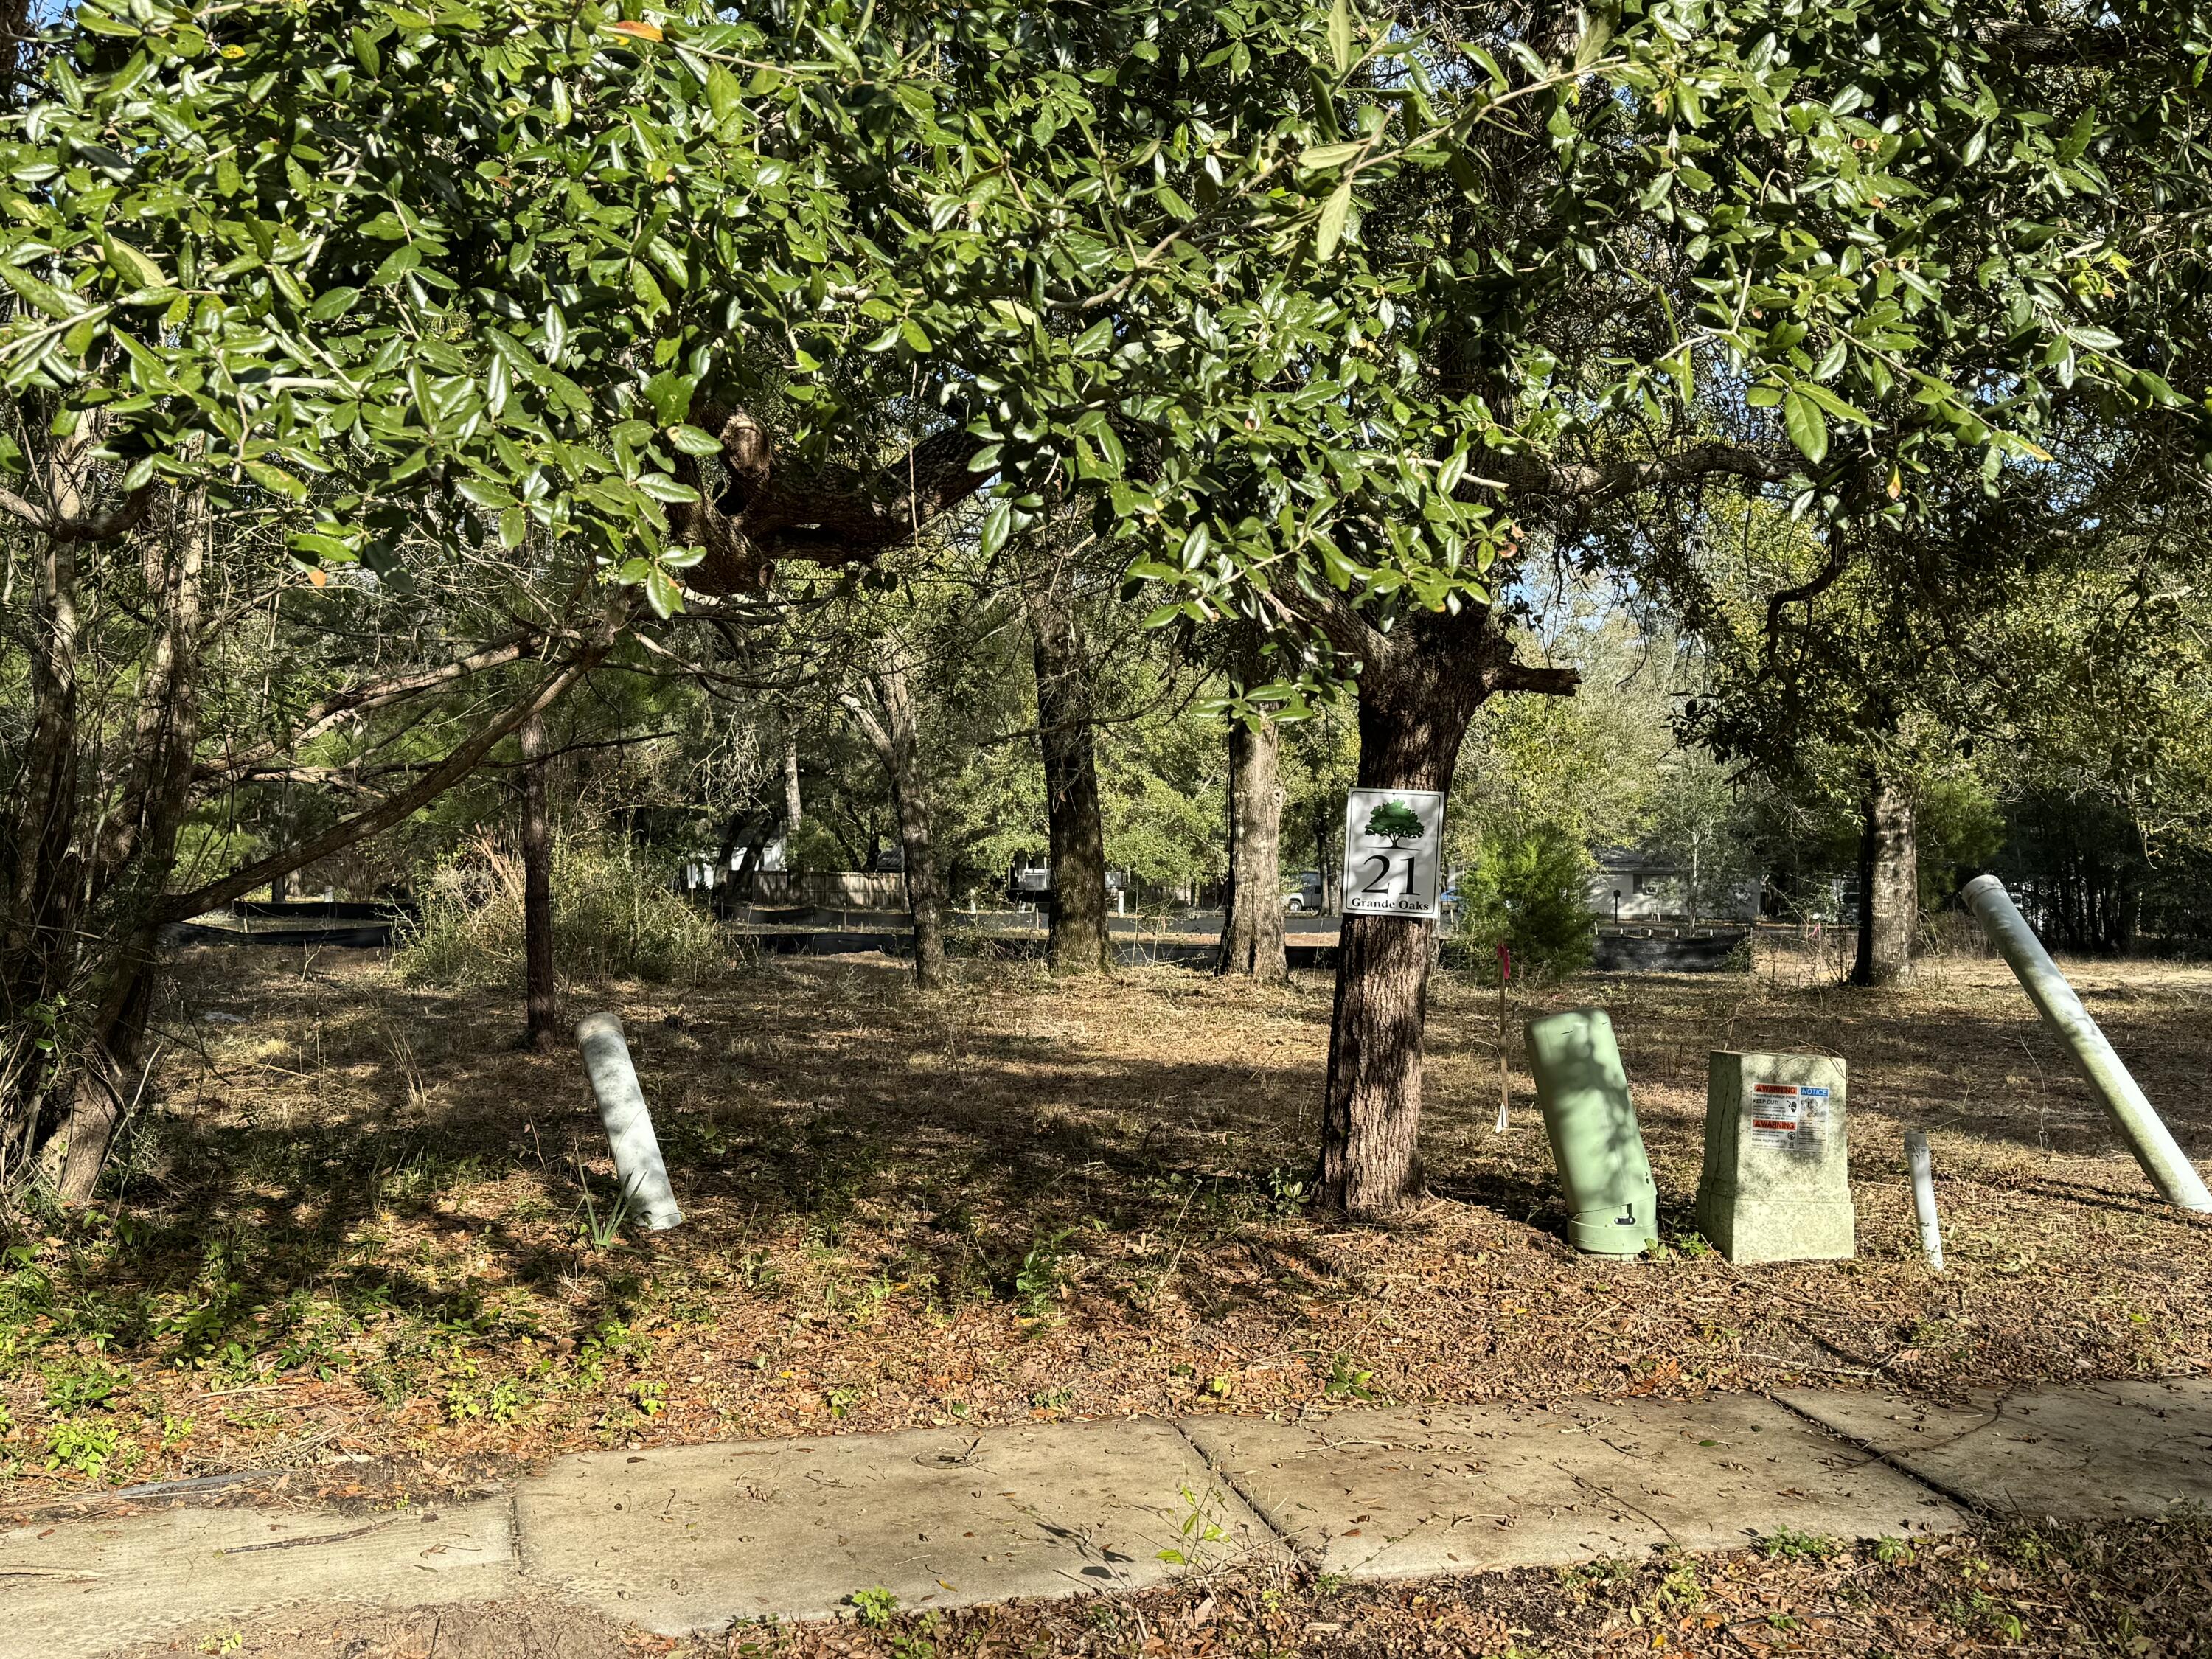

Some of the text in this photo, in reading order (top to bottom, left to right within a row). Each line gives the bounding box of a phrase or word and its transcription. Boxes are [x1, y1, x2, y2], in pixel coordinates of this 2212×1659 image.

[1361, 855, 1421, 897] 21
[1351, 897, 1429, 911] Grande Oaks
[1762, 1085, 1795, 1093] WARNING
[1761, 1120, 1795, 1129] WARNING
